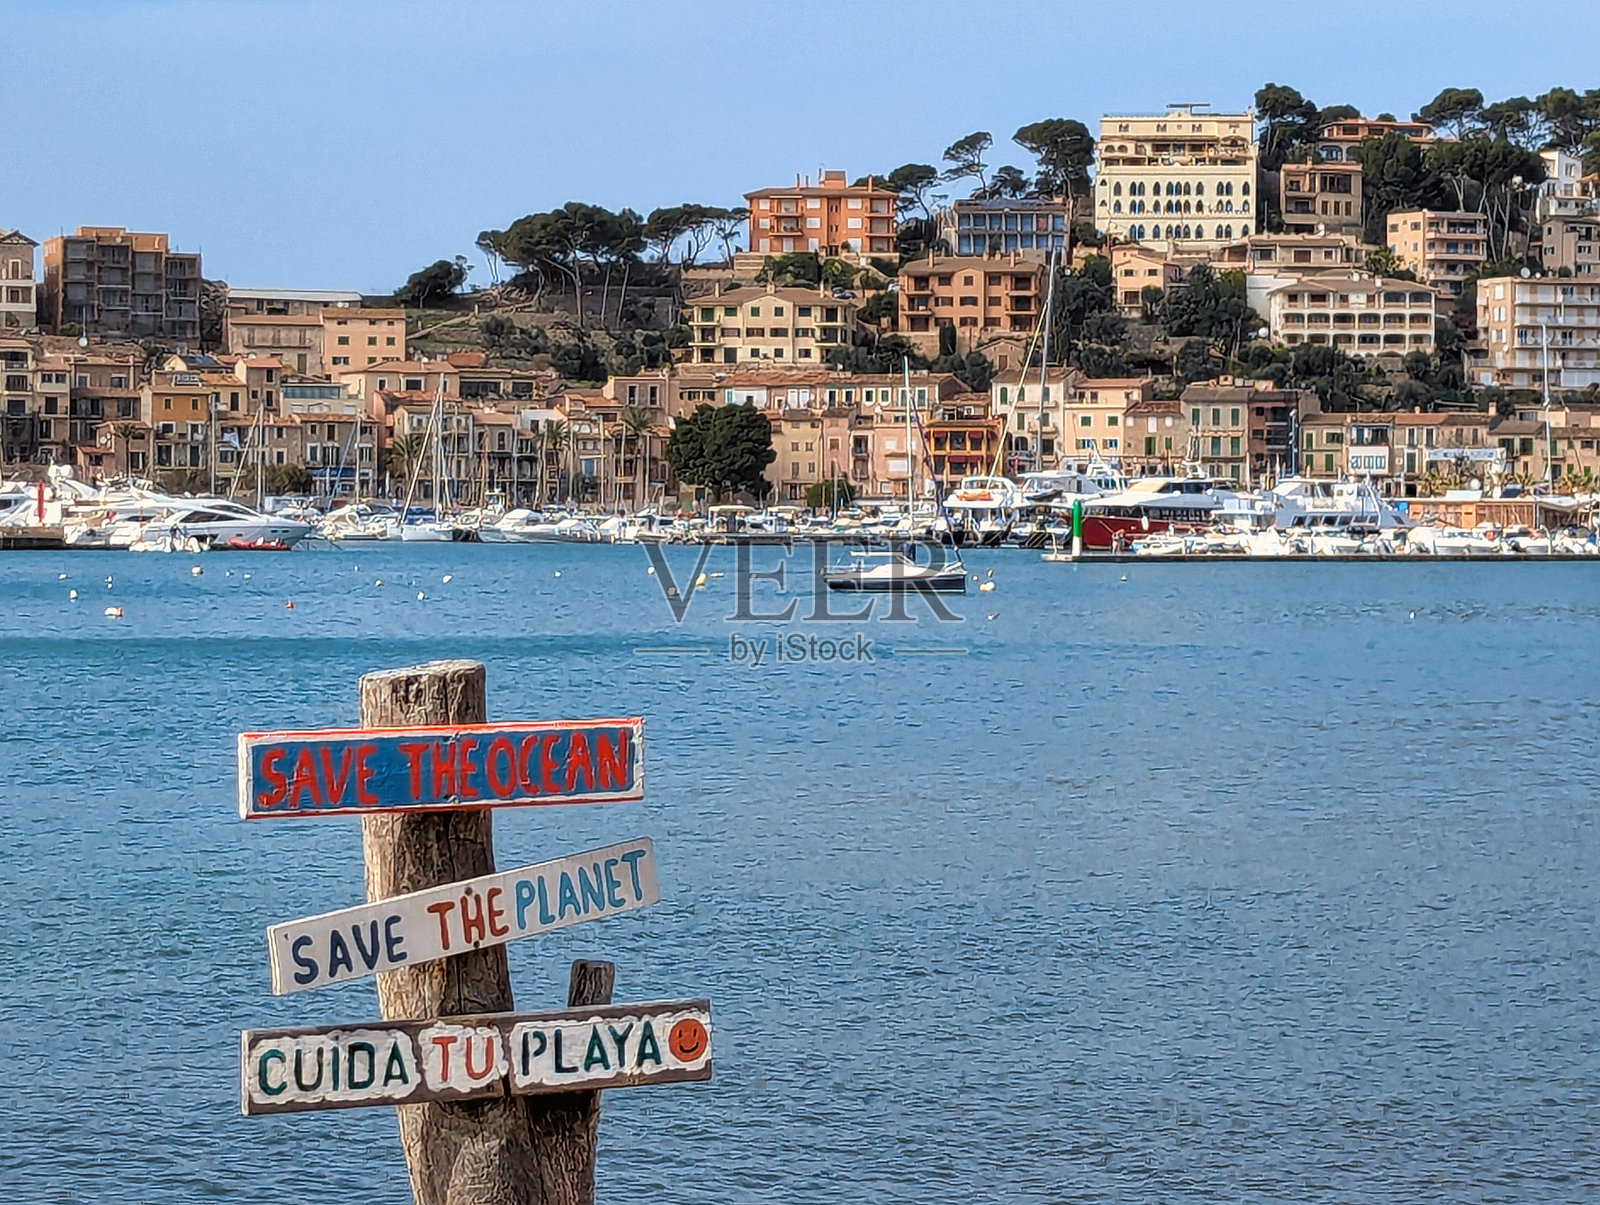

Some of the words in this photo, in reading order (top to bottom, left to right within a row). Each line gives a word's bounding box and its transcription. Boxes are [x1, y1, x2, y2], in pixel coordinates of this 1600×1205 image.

[258, 744, 381, 808] SAVE
[397, 739, 479, 800] THE
[486, 729, 629, 797] OCEAN
[291, 915, 407, 985] SAVE
[427, 885, 509, 950] THE
[515, 848, 647, 929] PLANET
[258, 1041, 409, 1095] CUIDA
[431, 1034, 494, 1081] TU
[521, 1020, 662, 1076] PLAYA
